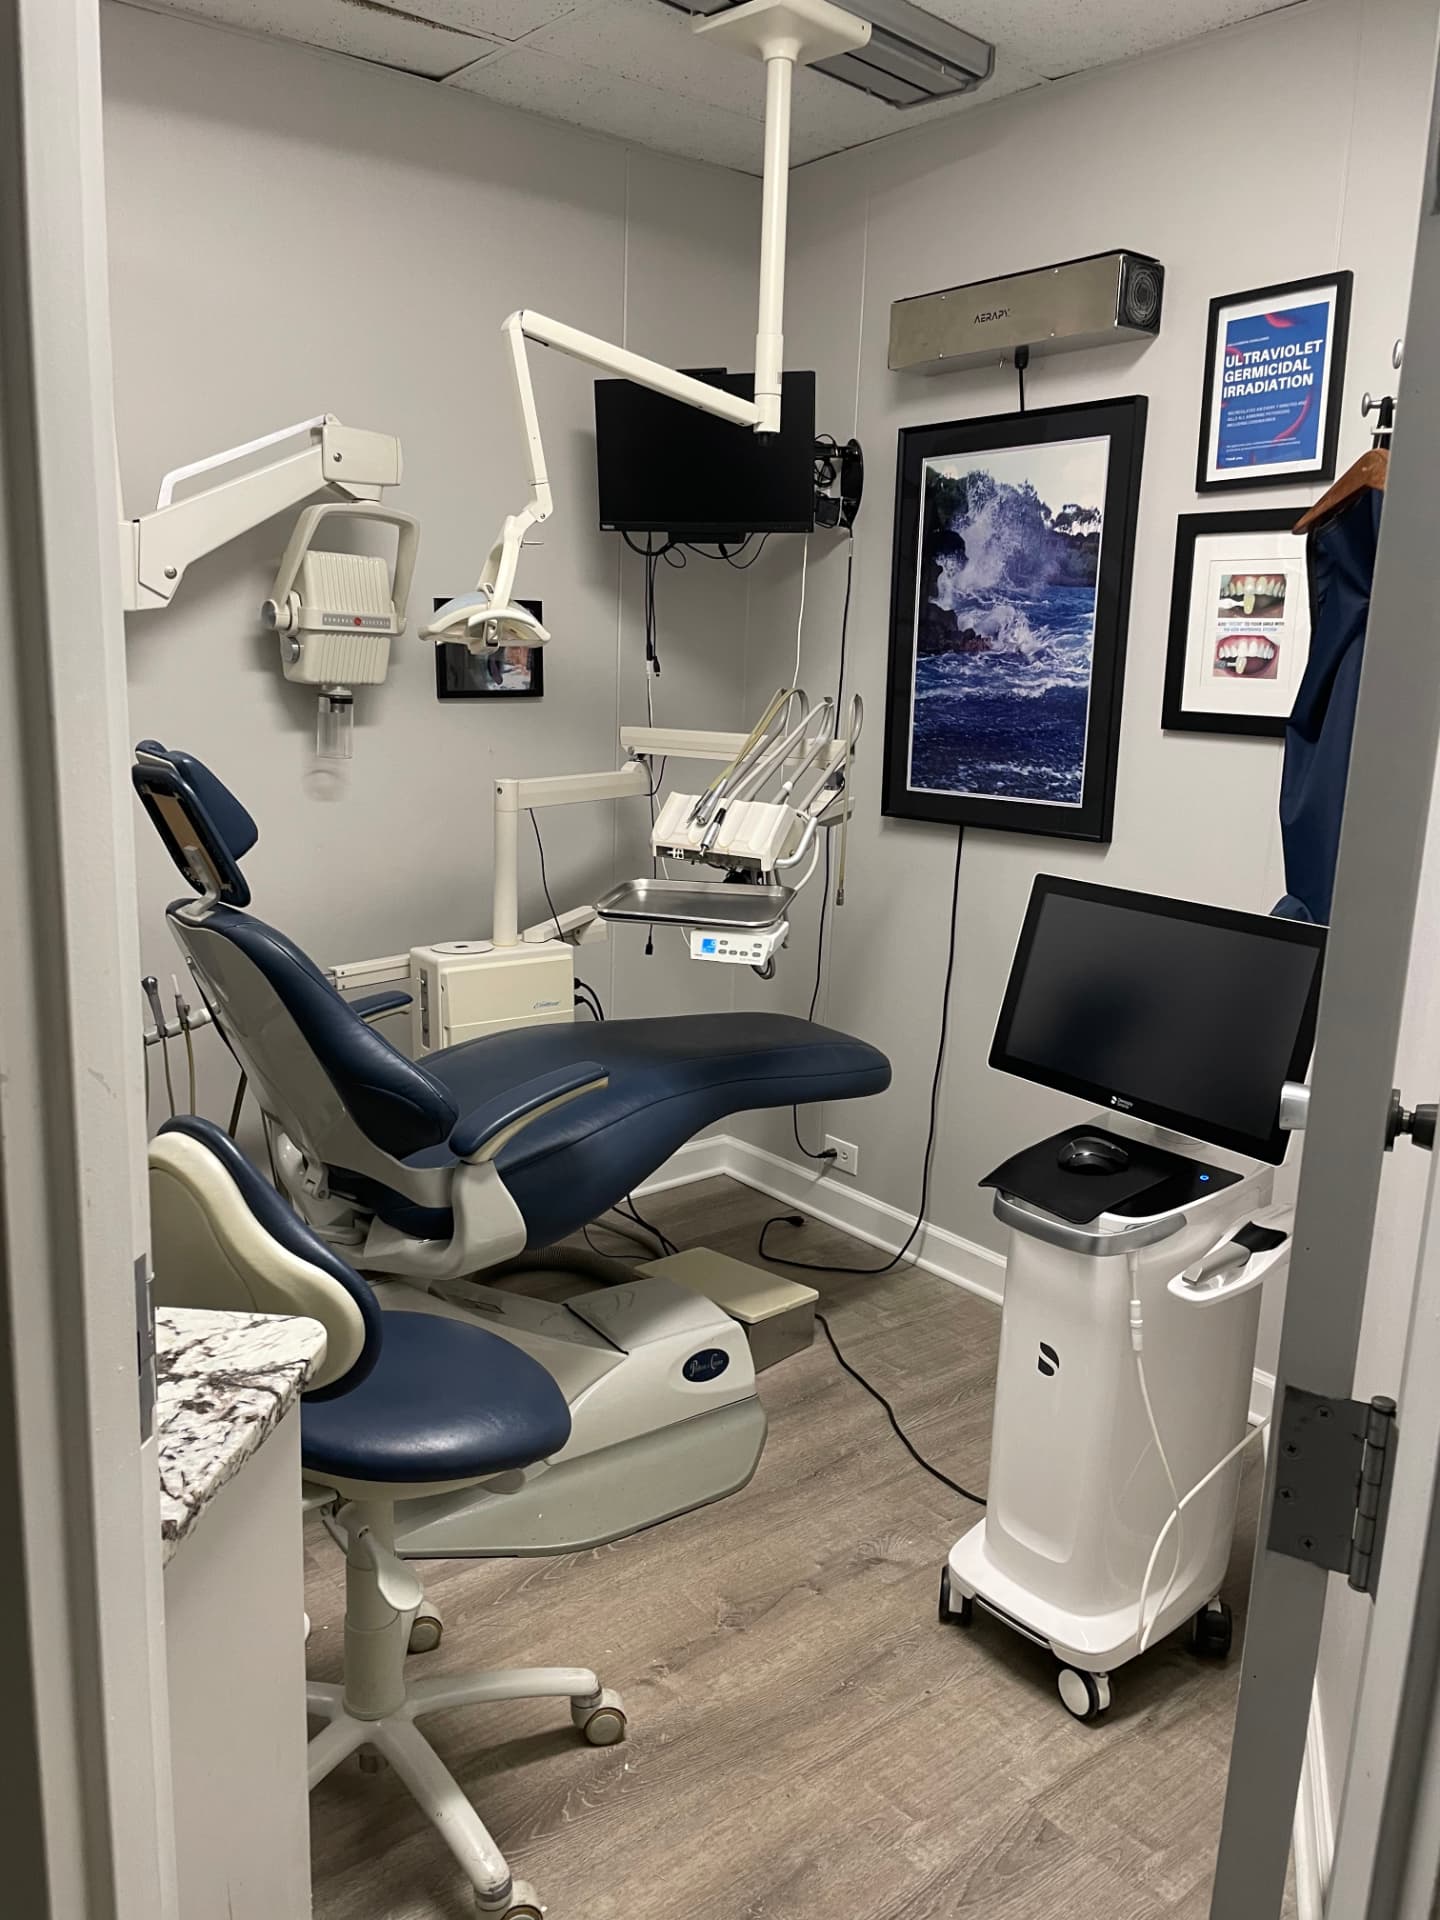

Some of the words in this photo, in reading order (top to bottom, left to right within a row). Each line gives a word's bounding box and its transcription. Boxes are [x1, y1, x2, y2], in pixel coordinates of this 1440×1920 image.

[974, 309, 1009, 324] AERAPY
[1225, 339, 1323, 368] ULTRAVIOLET
[1224, 358, 1312, 383] GERMICIDAL
[1223, 373, 1314, 399] IRRADIATION
